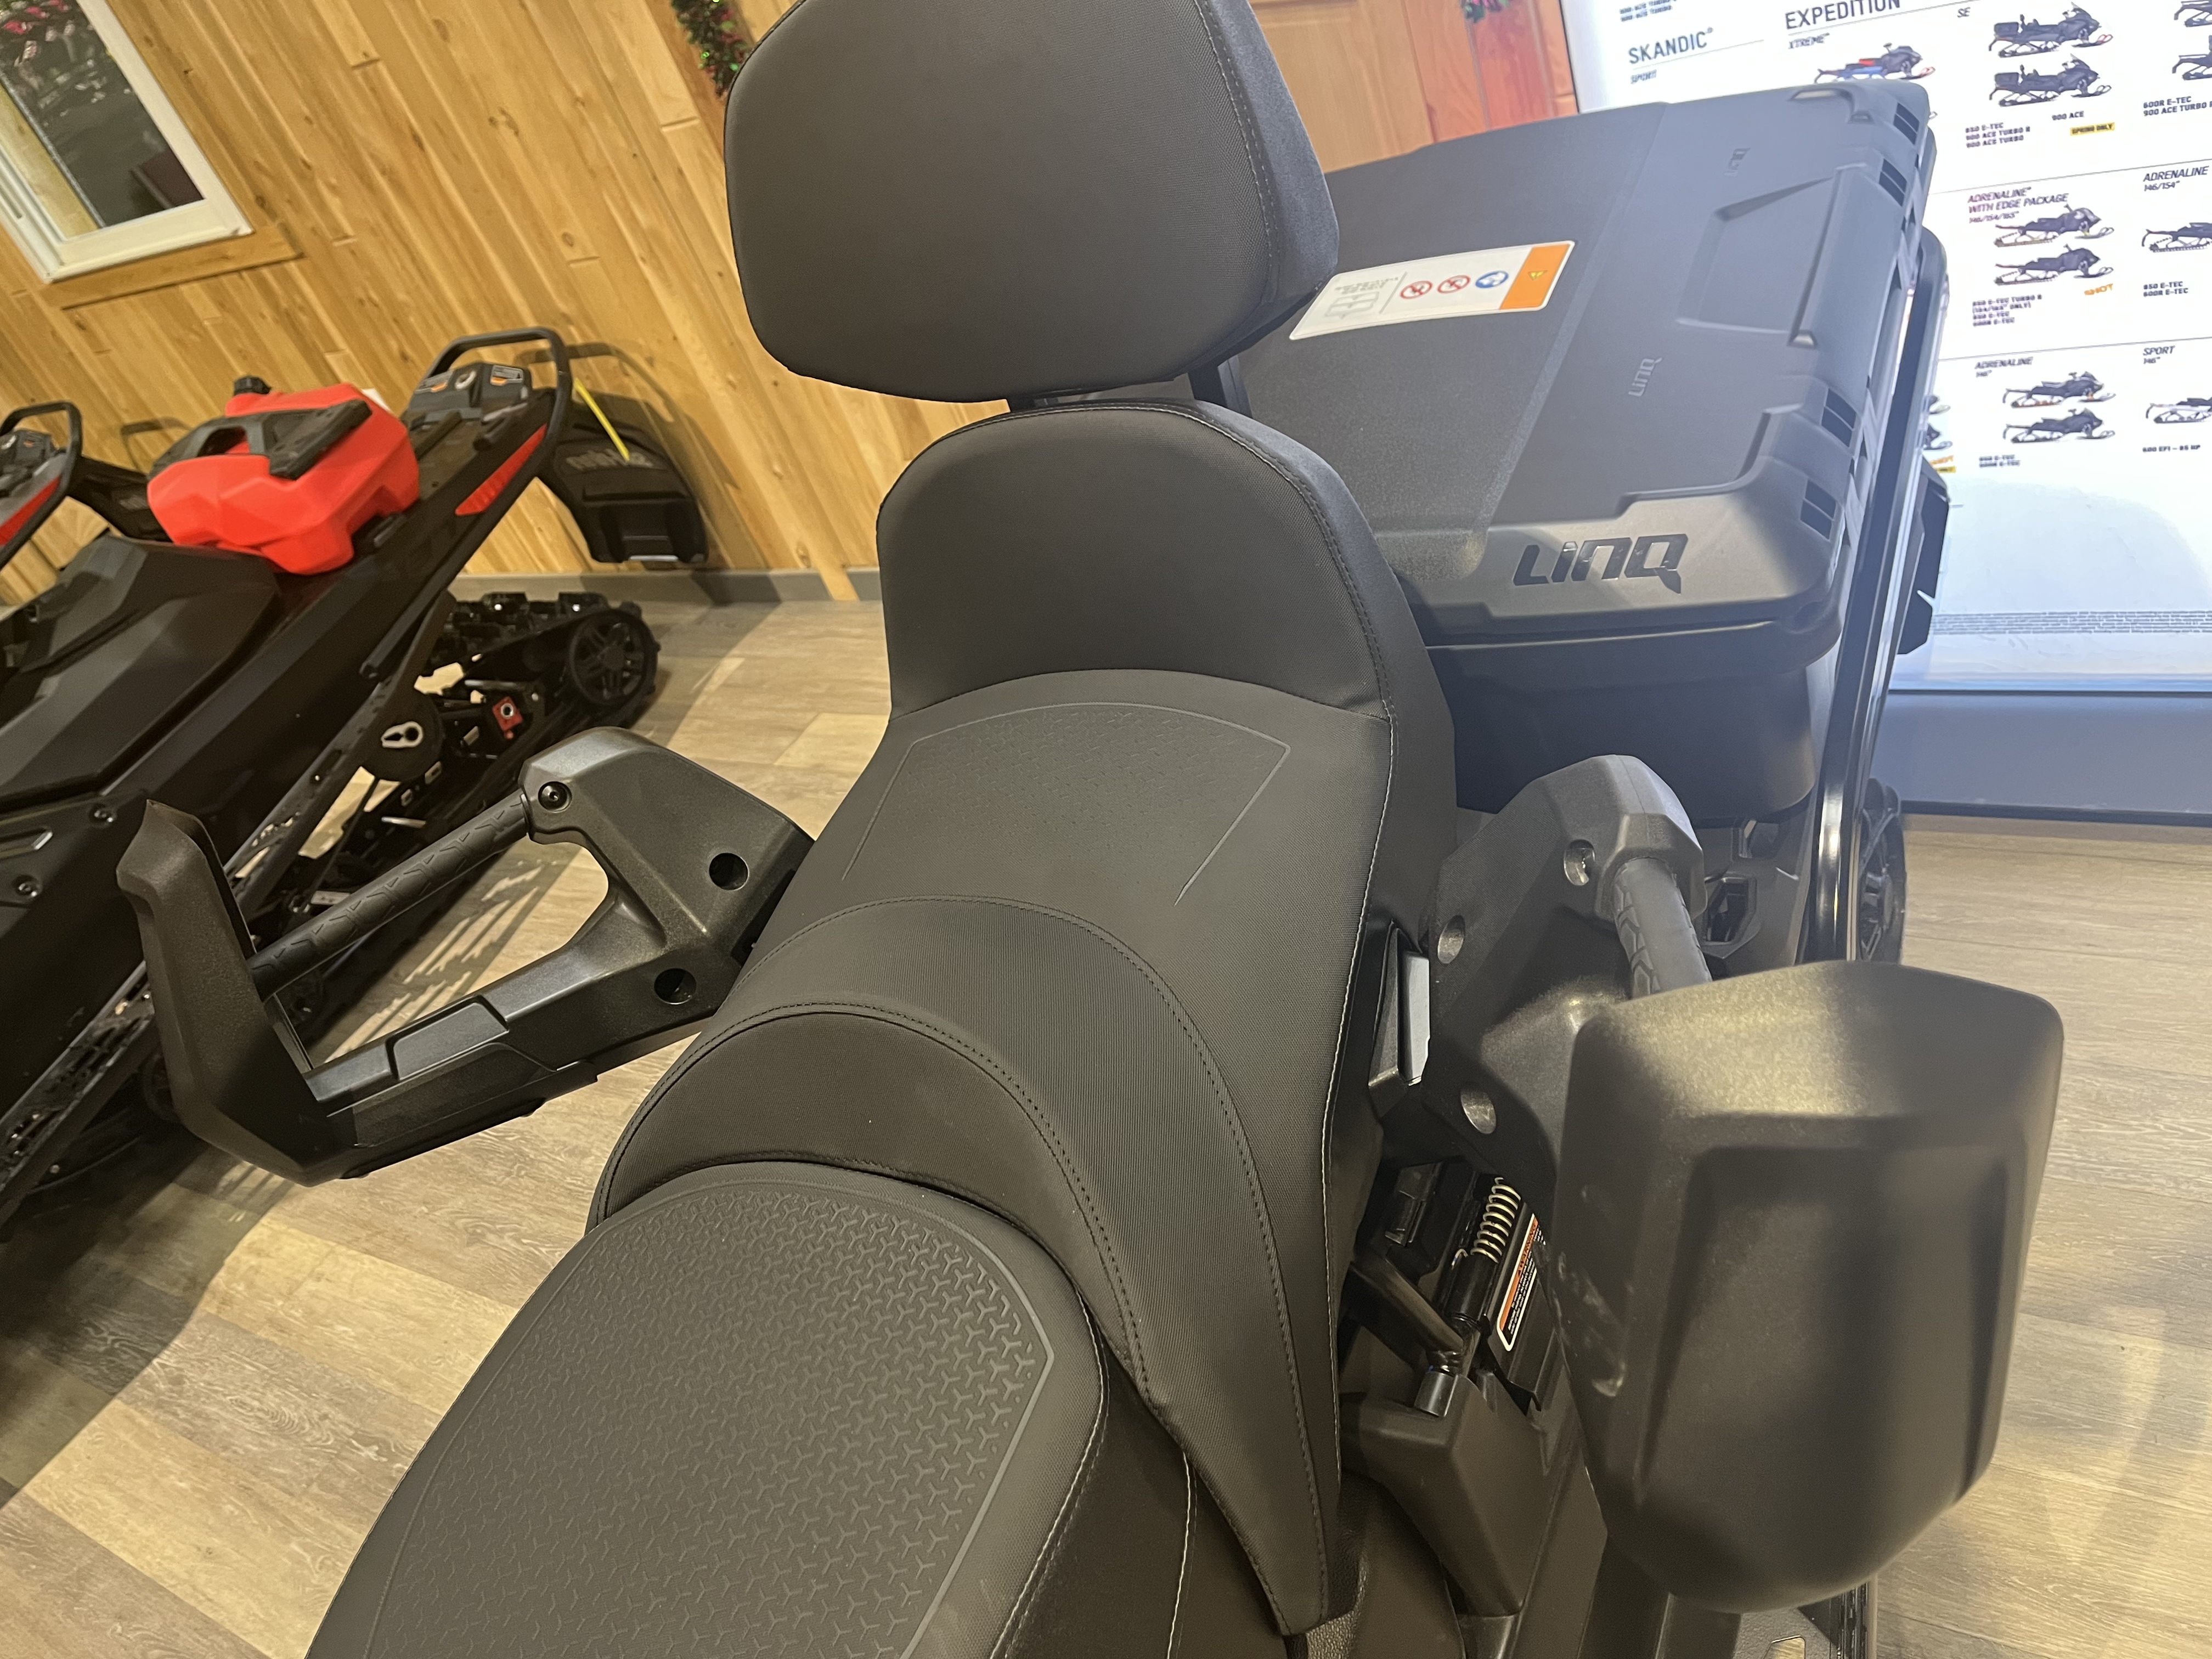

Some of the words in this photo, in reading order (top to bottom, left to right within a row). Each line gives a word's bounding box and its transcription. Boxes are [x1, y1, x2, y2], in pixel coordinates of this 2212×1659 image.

[2166, 95, 2192, 105] E-TEC
[2160, 106, 2178, 114] ACE
[2180, 102, 2207, 111] TURBO
[2069, 110, 2084, 119] ACE
[1999, 127, 2024, 136] TURBO
[1999, 134, 2024, 144] TURBO
[1969, 202, 1994, 213] WITH
[1996, 198, 2022, 211] EDGE
[2023, 193, 2069, 207] PACKAGE
[2160, 280, 2183, 289] E-TEC
[2165, 287, 2189, 296] E-TEC
[2143, 345, 2176, 356] SPORT
[1520, 1223, 1537, 1268] WARNING
